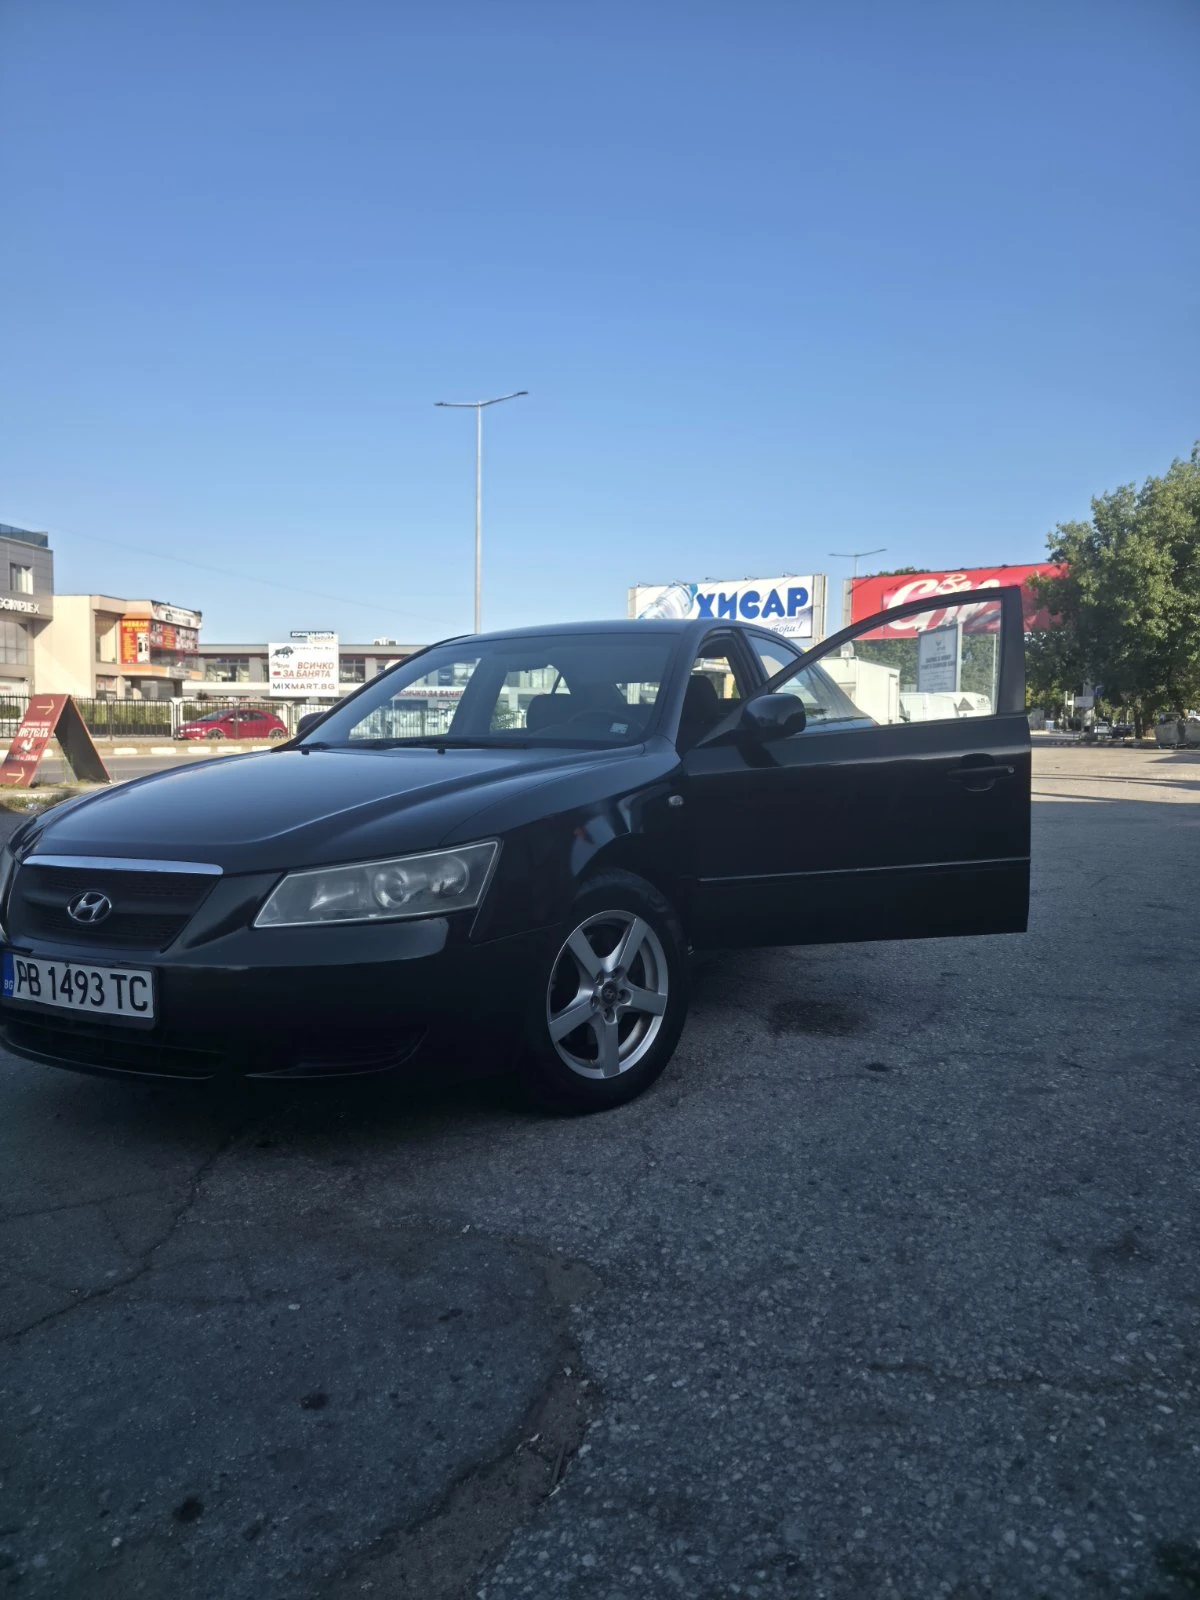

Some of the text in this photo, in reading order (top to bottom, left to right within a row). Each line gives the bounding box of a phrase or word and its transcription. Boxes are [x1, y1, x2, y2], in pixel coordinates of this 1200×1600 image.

[696, 587, 809, 619] ХИСАР
[297, 662, 334, 670] ВСИЧКО
[283, 669, 331, 678] ЗА БАНЯТА
[272, 682, 336, 691] MIXMART.BG
[4, 979, 14, 990] BG
[48, 966, 105, 1007] 1493
[110, 973, 148, 1012] TC
